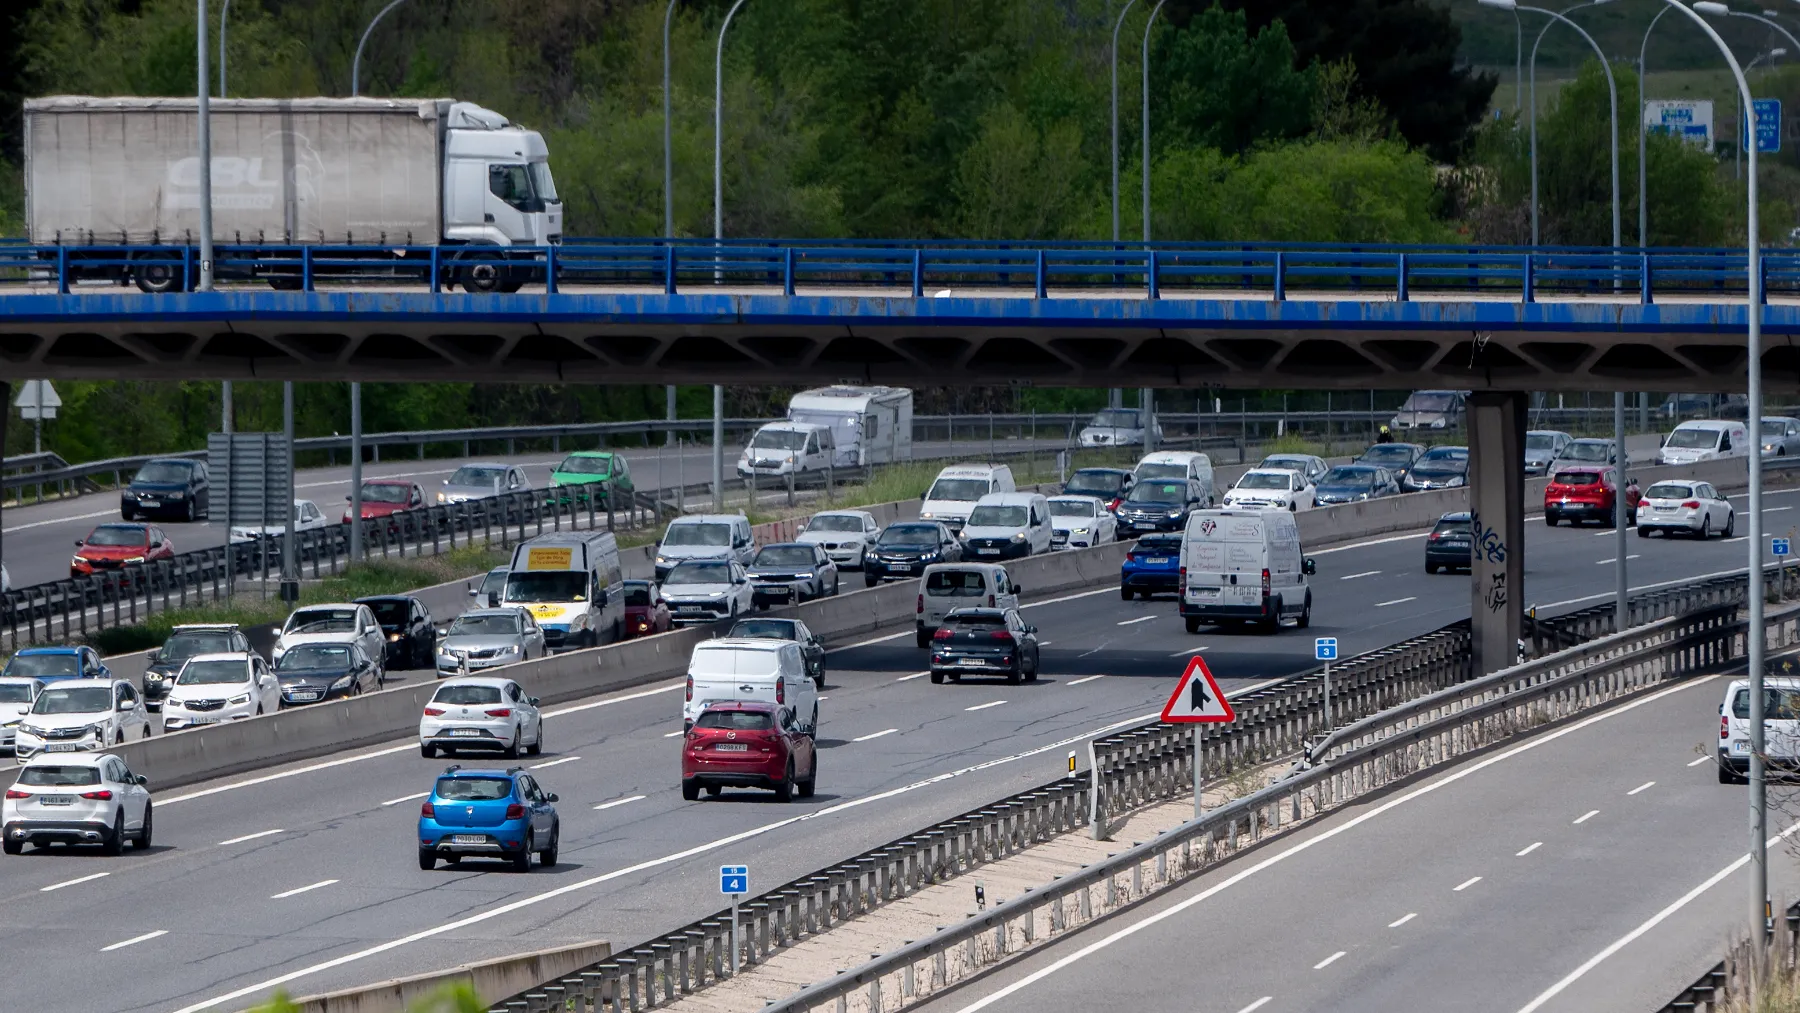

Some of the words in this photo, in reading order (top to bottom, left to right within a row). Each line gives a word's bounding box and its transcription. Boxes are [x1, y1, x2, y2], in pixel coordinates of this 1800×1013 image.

[169, 156, 279, 188] CBL
[1323, 647, 1330, 656] 3
[729, 879, 739, 889] 4
